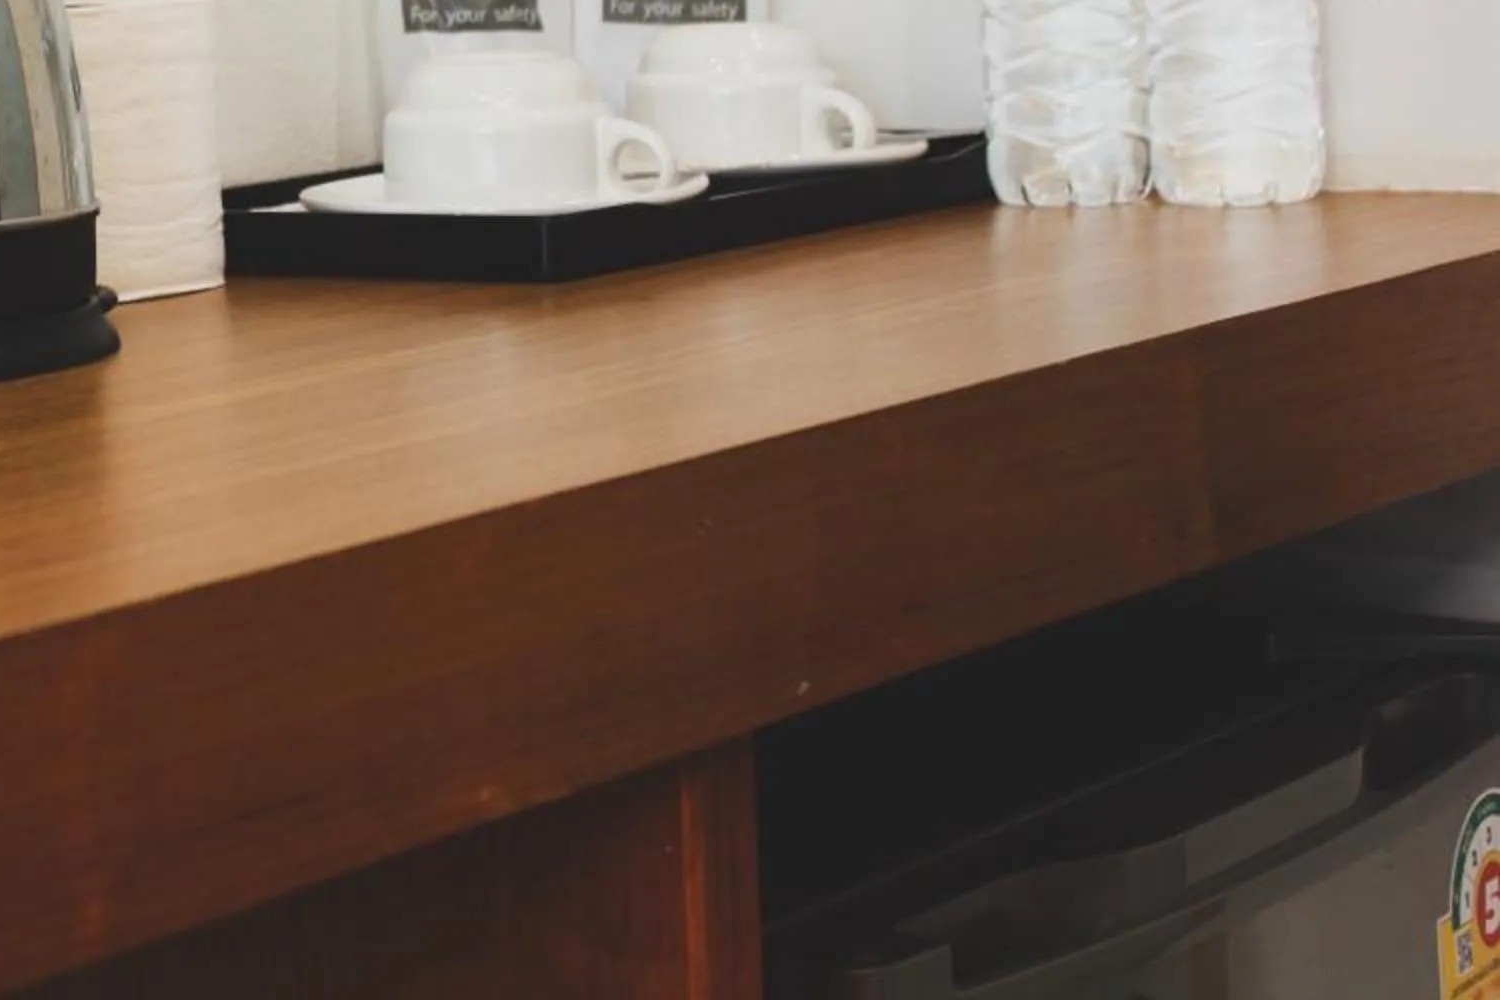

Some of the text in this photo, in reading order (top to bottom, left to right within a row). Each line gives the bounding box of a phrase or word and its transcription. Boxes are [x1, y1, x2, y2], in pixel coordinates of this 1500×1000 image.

[410, 4, 537, 27] For your safety
[643, 0, 684, 21] your
[1484, 874, 1500, 936] 5
